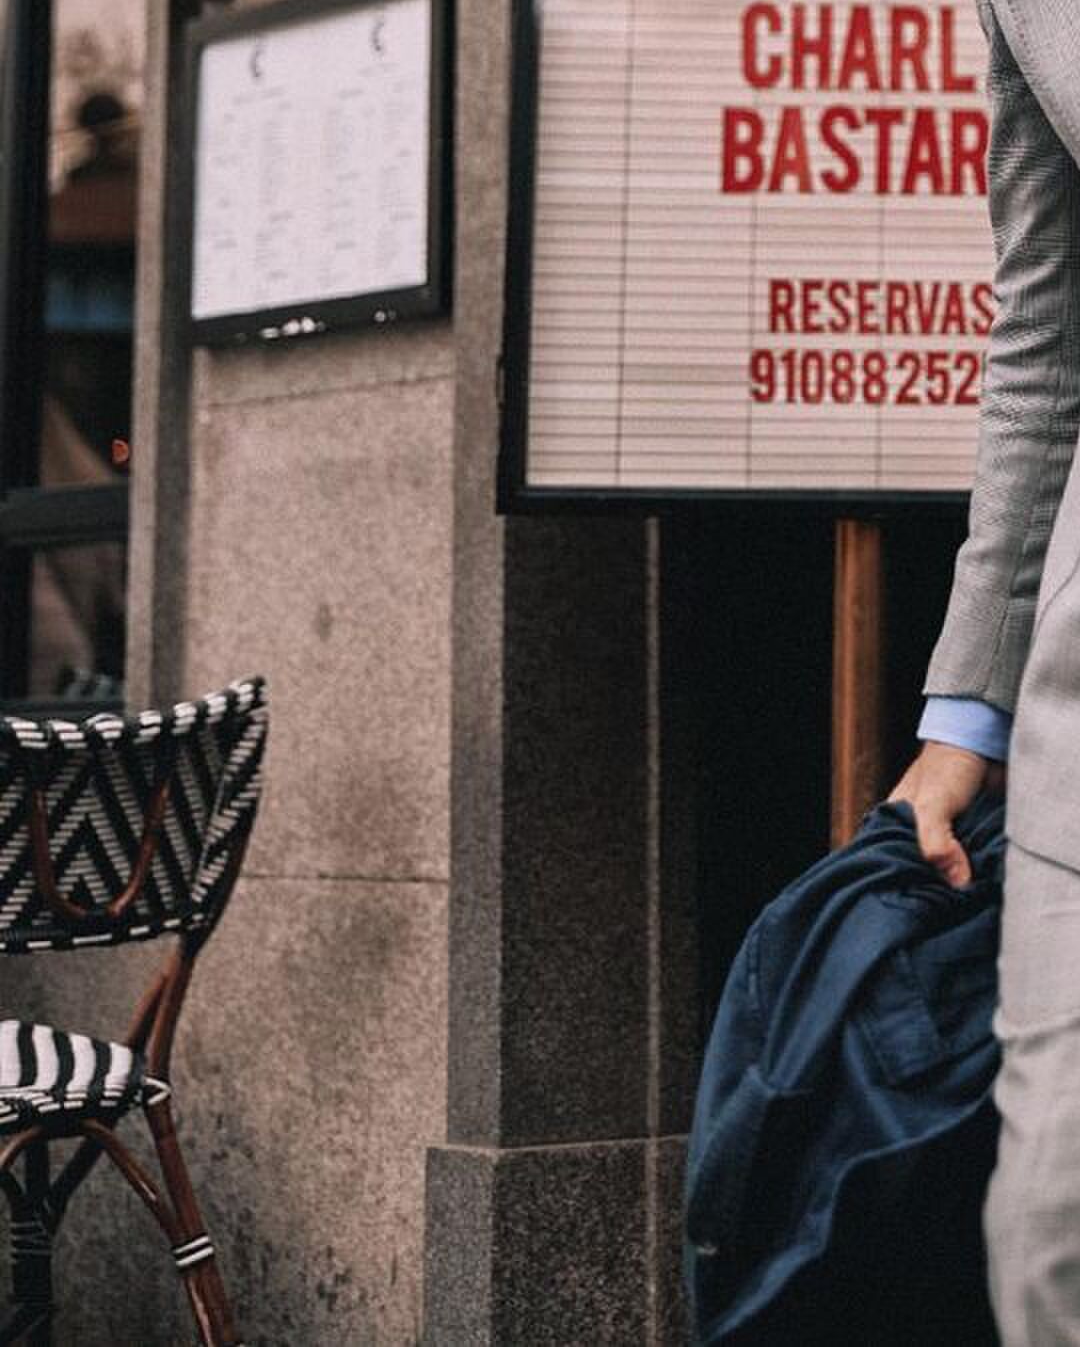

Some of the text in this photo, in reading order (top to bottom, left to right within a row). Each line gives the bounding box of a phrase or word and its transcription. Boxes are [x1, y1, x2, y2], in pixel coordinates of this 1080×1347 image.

[740, 1, 977, 93] CHARL
[721, 104, 990, 196] BASTAR
[769, 279, 995, 337] RESERVAS
[749, 349, 985, 405] 91088252
